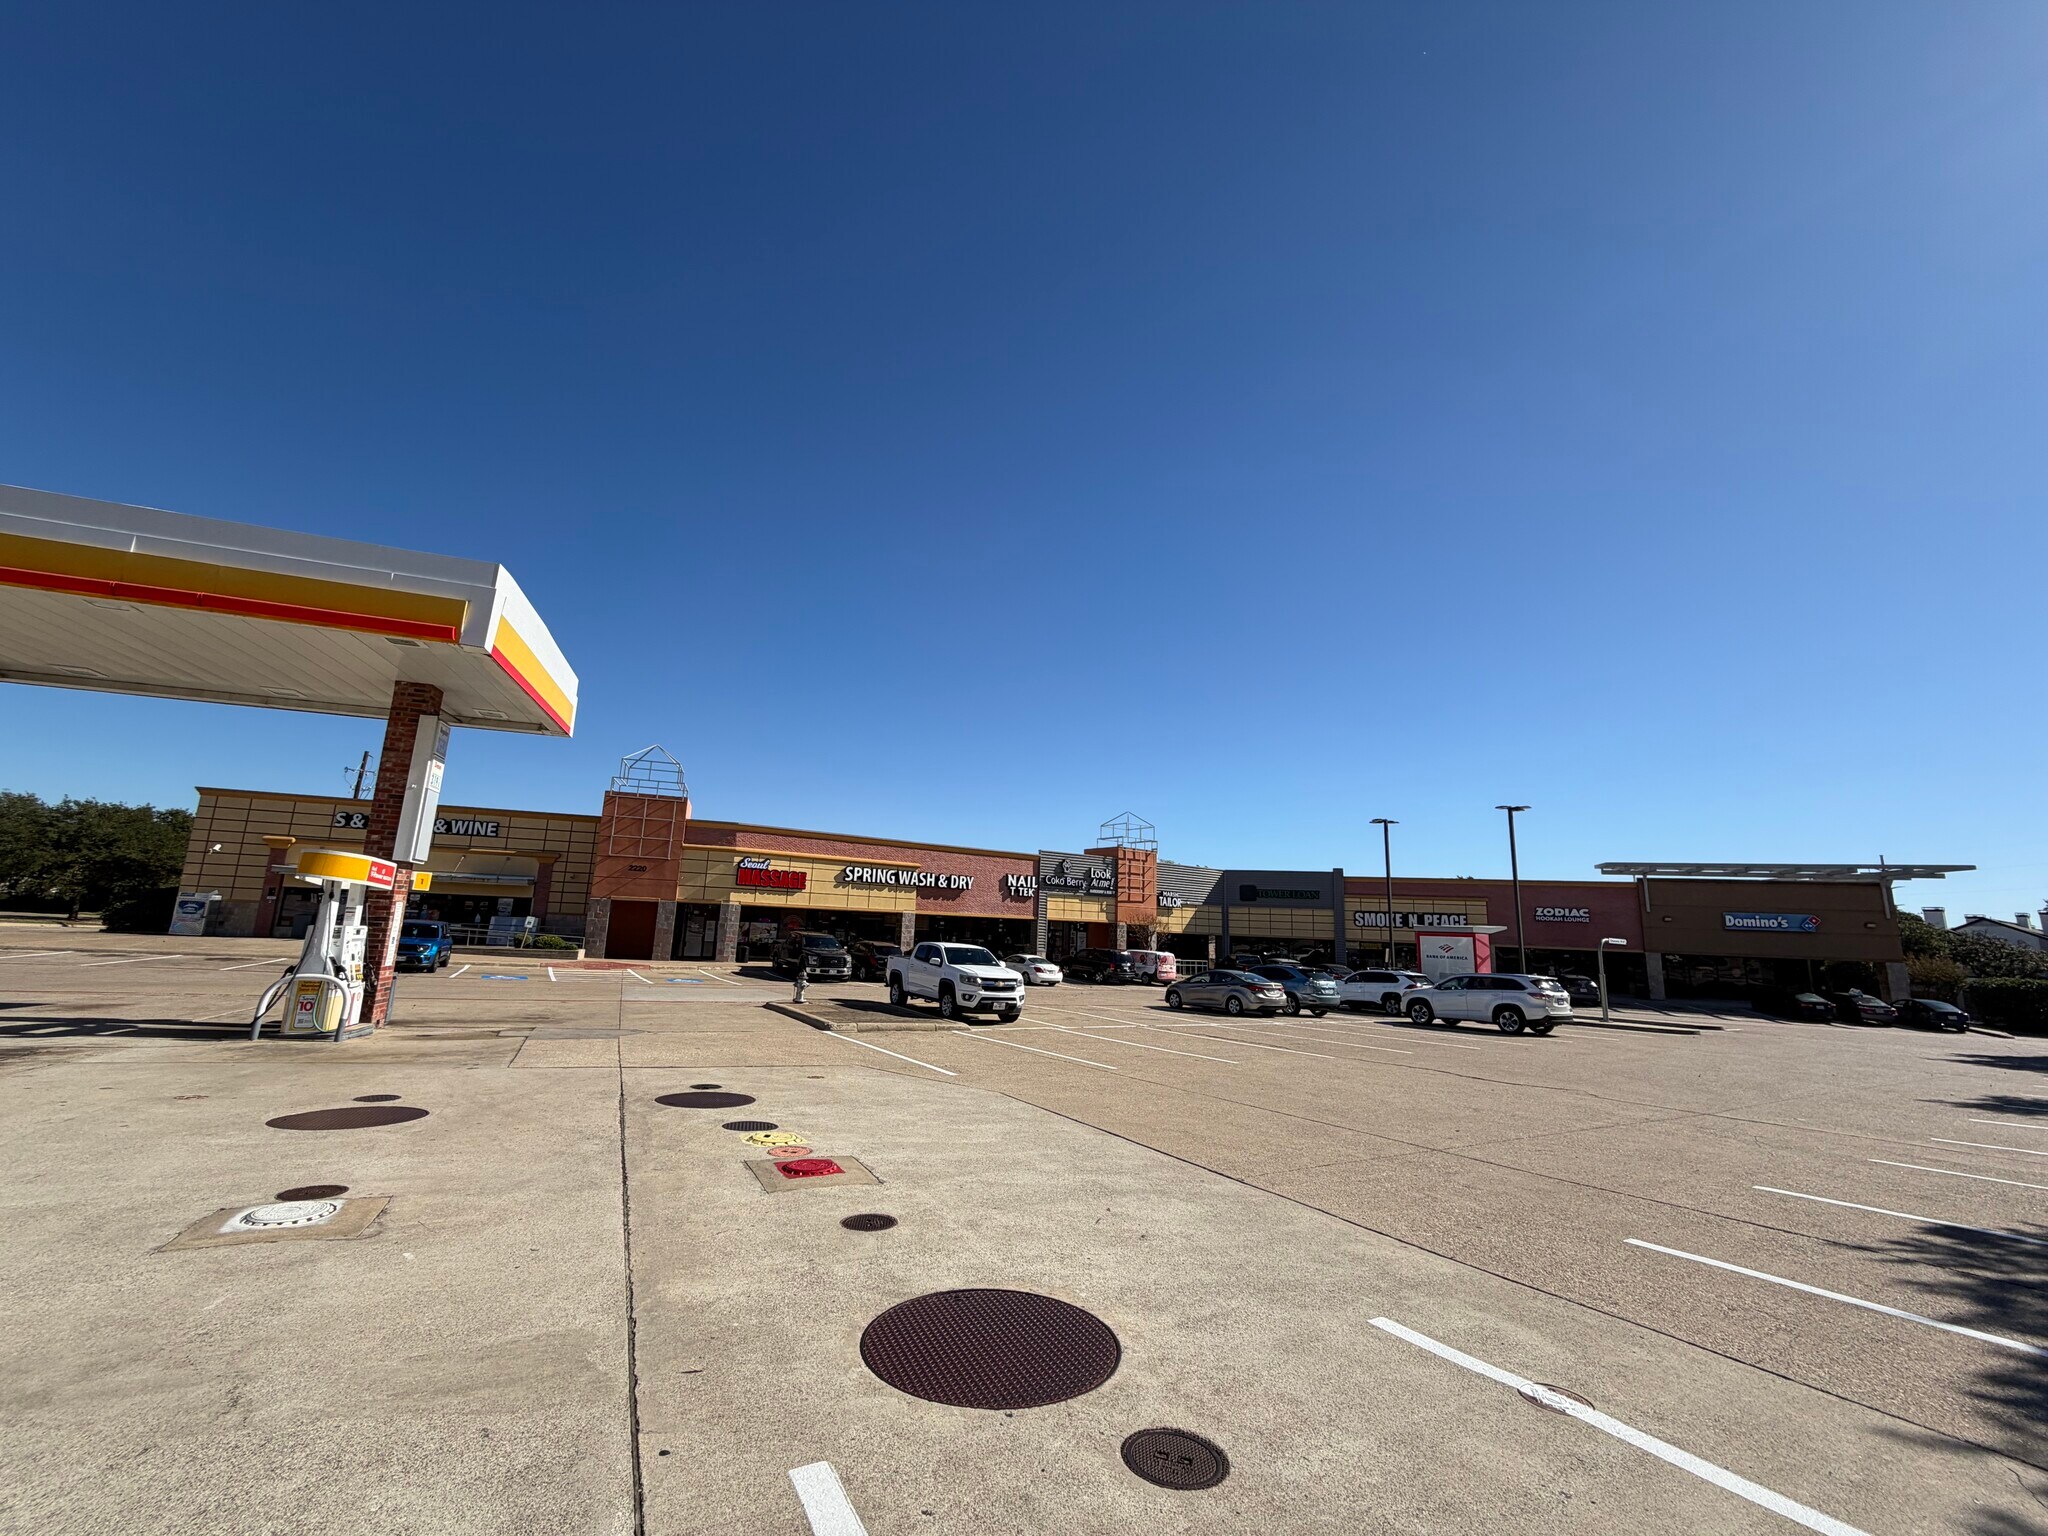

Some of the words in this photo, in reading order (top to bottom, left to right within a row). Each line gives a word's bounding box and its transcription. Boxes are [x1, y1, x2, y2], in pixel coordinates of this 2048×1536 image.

[335, 812, 346, 827] S
[350, 813, 365, 828] &
[434, 819, 447, 834] &
[452, 820, 498, 836] WINE
[740, 857, 770, 870] Seoul
[737, 868, 807, 889] MASSAGE
[845, 866, 897, 884] SPRING
[898, 871, 935, 887] WASH
[938, 874, 948, 888] &
[951, 876, 974, 890] DRY
[1091, 867, 1111, 880] Look
[1008, 874, 1038, 888] NAIL
[1045, 875, 1065, 886] Coko
[1066, 877, 1088, 889] Berry
[1018, 887, 1035, 897] TEK
[1257, 889, 1290, 898] TOWER
[1292, 890, 1319, 899] LOAN
[1159, 896, 1182, 908] TAILOR
[1535, 907, 1590, 917] ZODIAC
[1354, 912, 1403, 928] SMOKE
[1408, 914, 1418, 928] N
[1424, 914, 1467, 926] PEACE
[1725, 915, 1789, 928] Domino's
